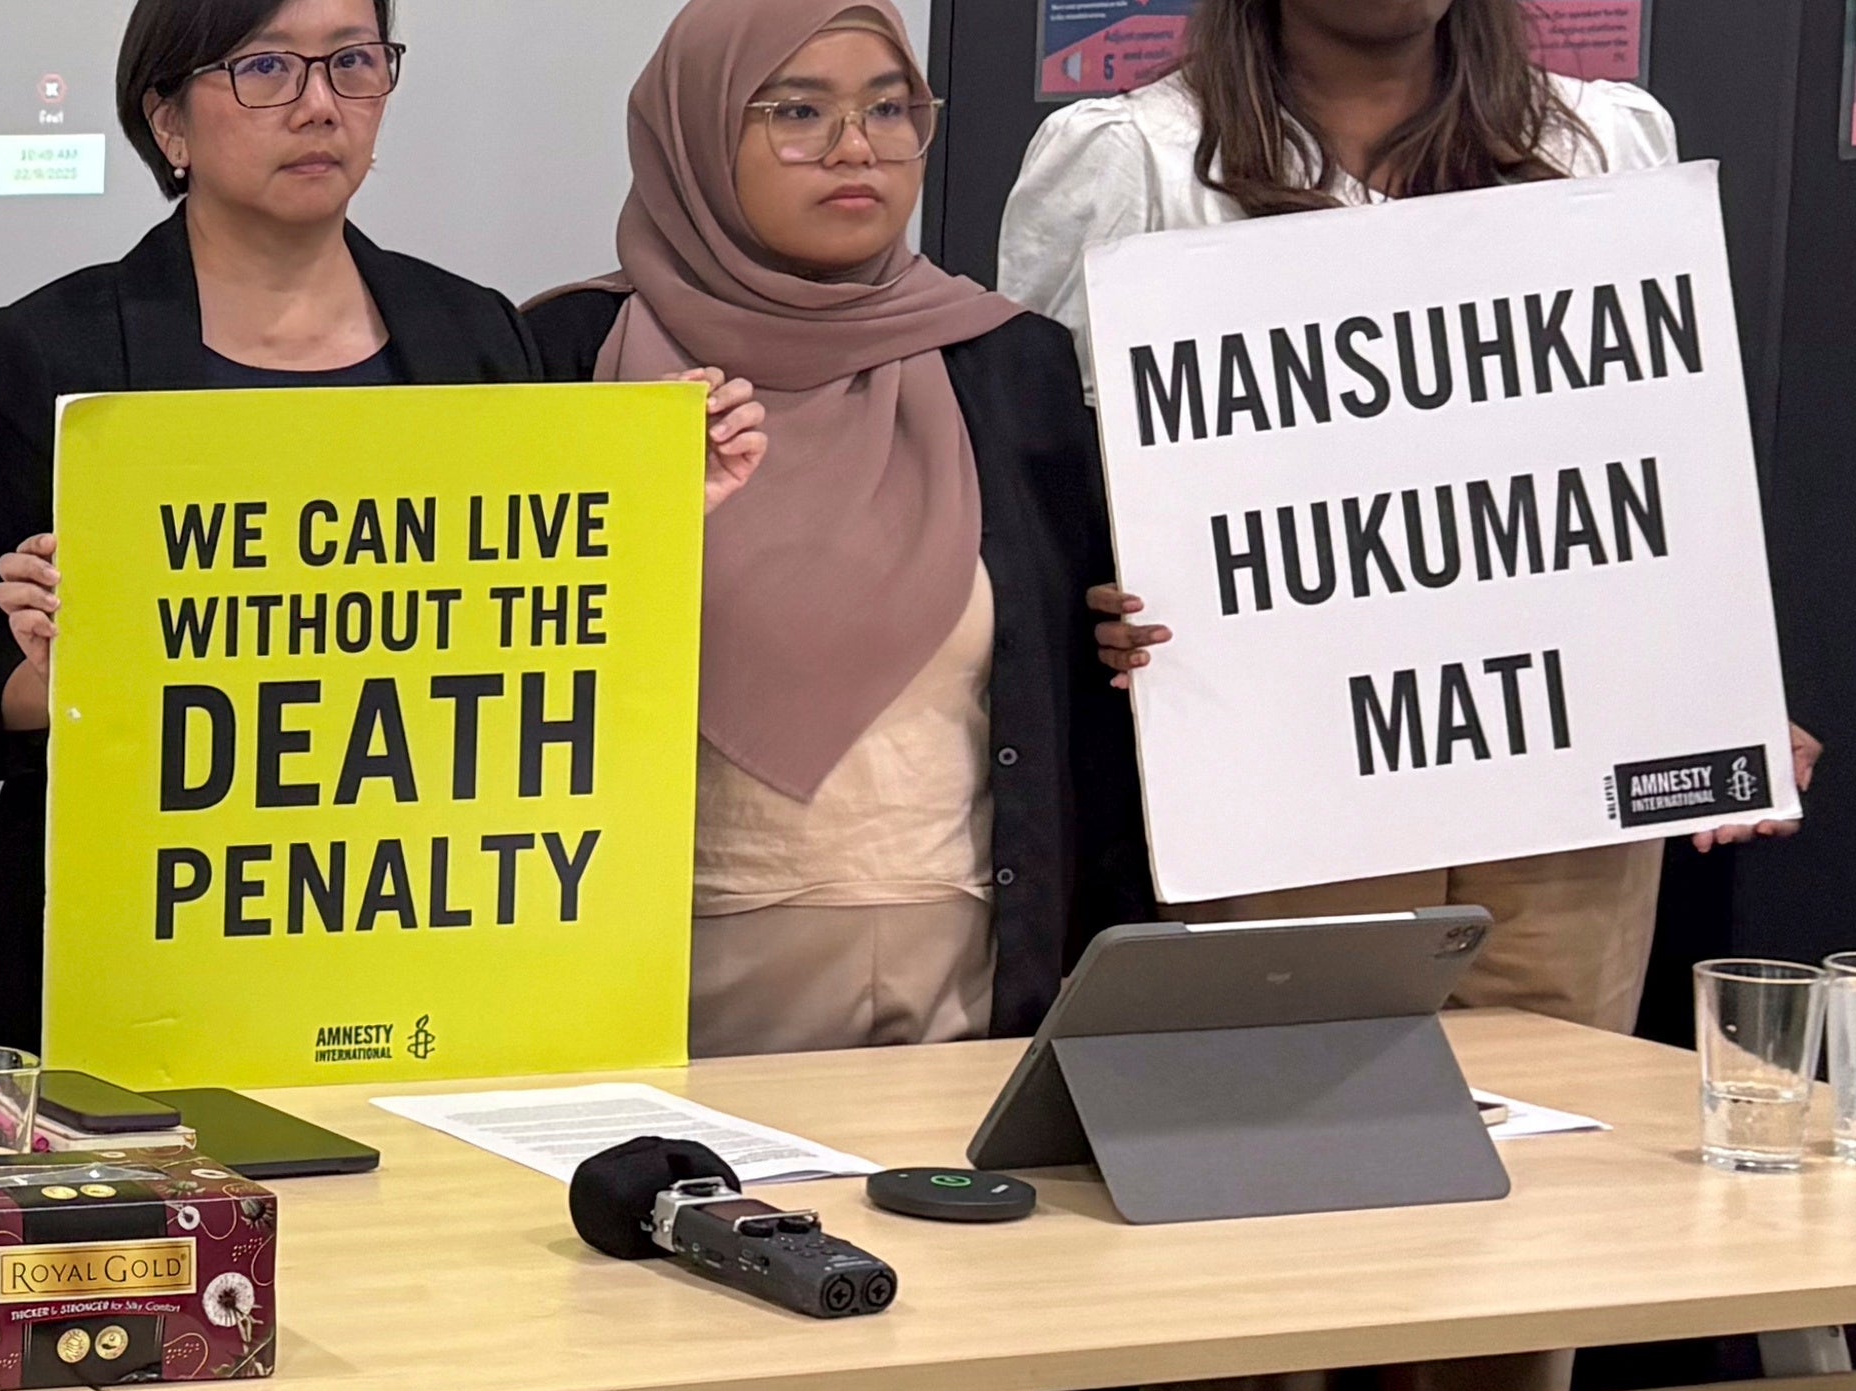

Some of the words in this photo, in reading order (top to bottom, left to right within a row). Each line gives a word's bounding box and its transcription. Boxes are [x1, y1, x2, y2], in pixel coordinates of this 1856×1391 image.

[1104, 53, 1115, 81] 5
[1129, 273, 1704, 447] MANSUHKAN
[160, 501, 268, 570] WE
[298, 496, 437, 566] CAN
[467, 490, 610, 561] LIVE
[1210, 457, 1669, 616] HUKUMAN
[157, 588, 462, 659] WITHOUT
[490, 583, 608, 648] THE
[159, 669, 597, 812] DEATH
[1349, 649, 1571, 776] MATI
[1630, 765, 1713, 797] AMNESTY
[1631, 789, 1716, 813] INTERNATIONAL
[154, 829, 602, 941] PENALTY
[315, 1024, 394, 1047] AMNESTY
[315, 1046, 393, 1063] INTERNATIONAL
[12, 1262, 97, 1293] ROYAL
[104, 1255, 181, 1283] GOLD
[11, 1307, 50, 1321] THICKER
[60, 1300, 109, 1316] STRONGER
[111, 1301, 123, 1311] for
[145, 1300, 181, 1314] Comfort
